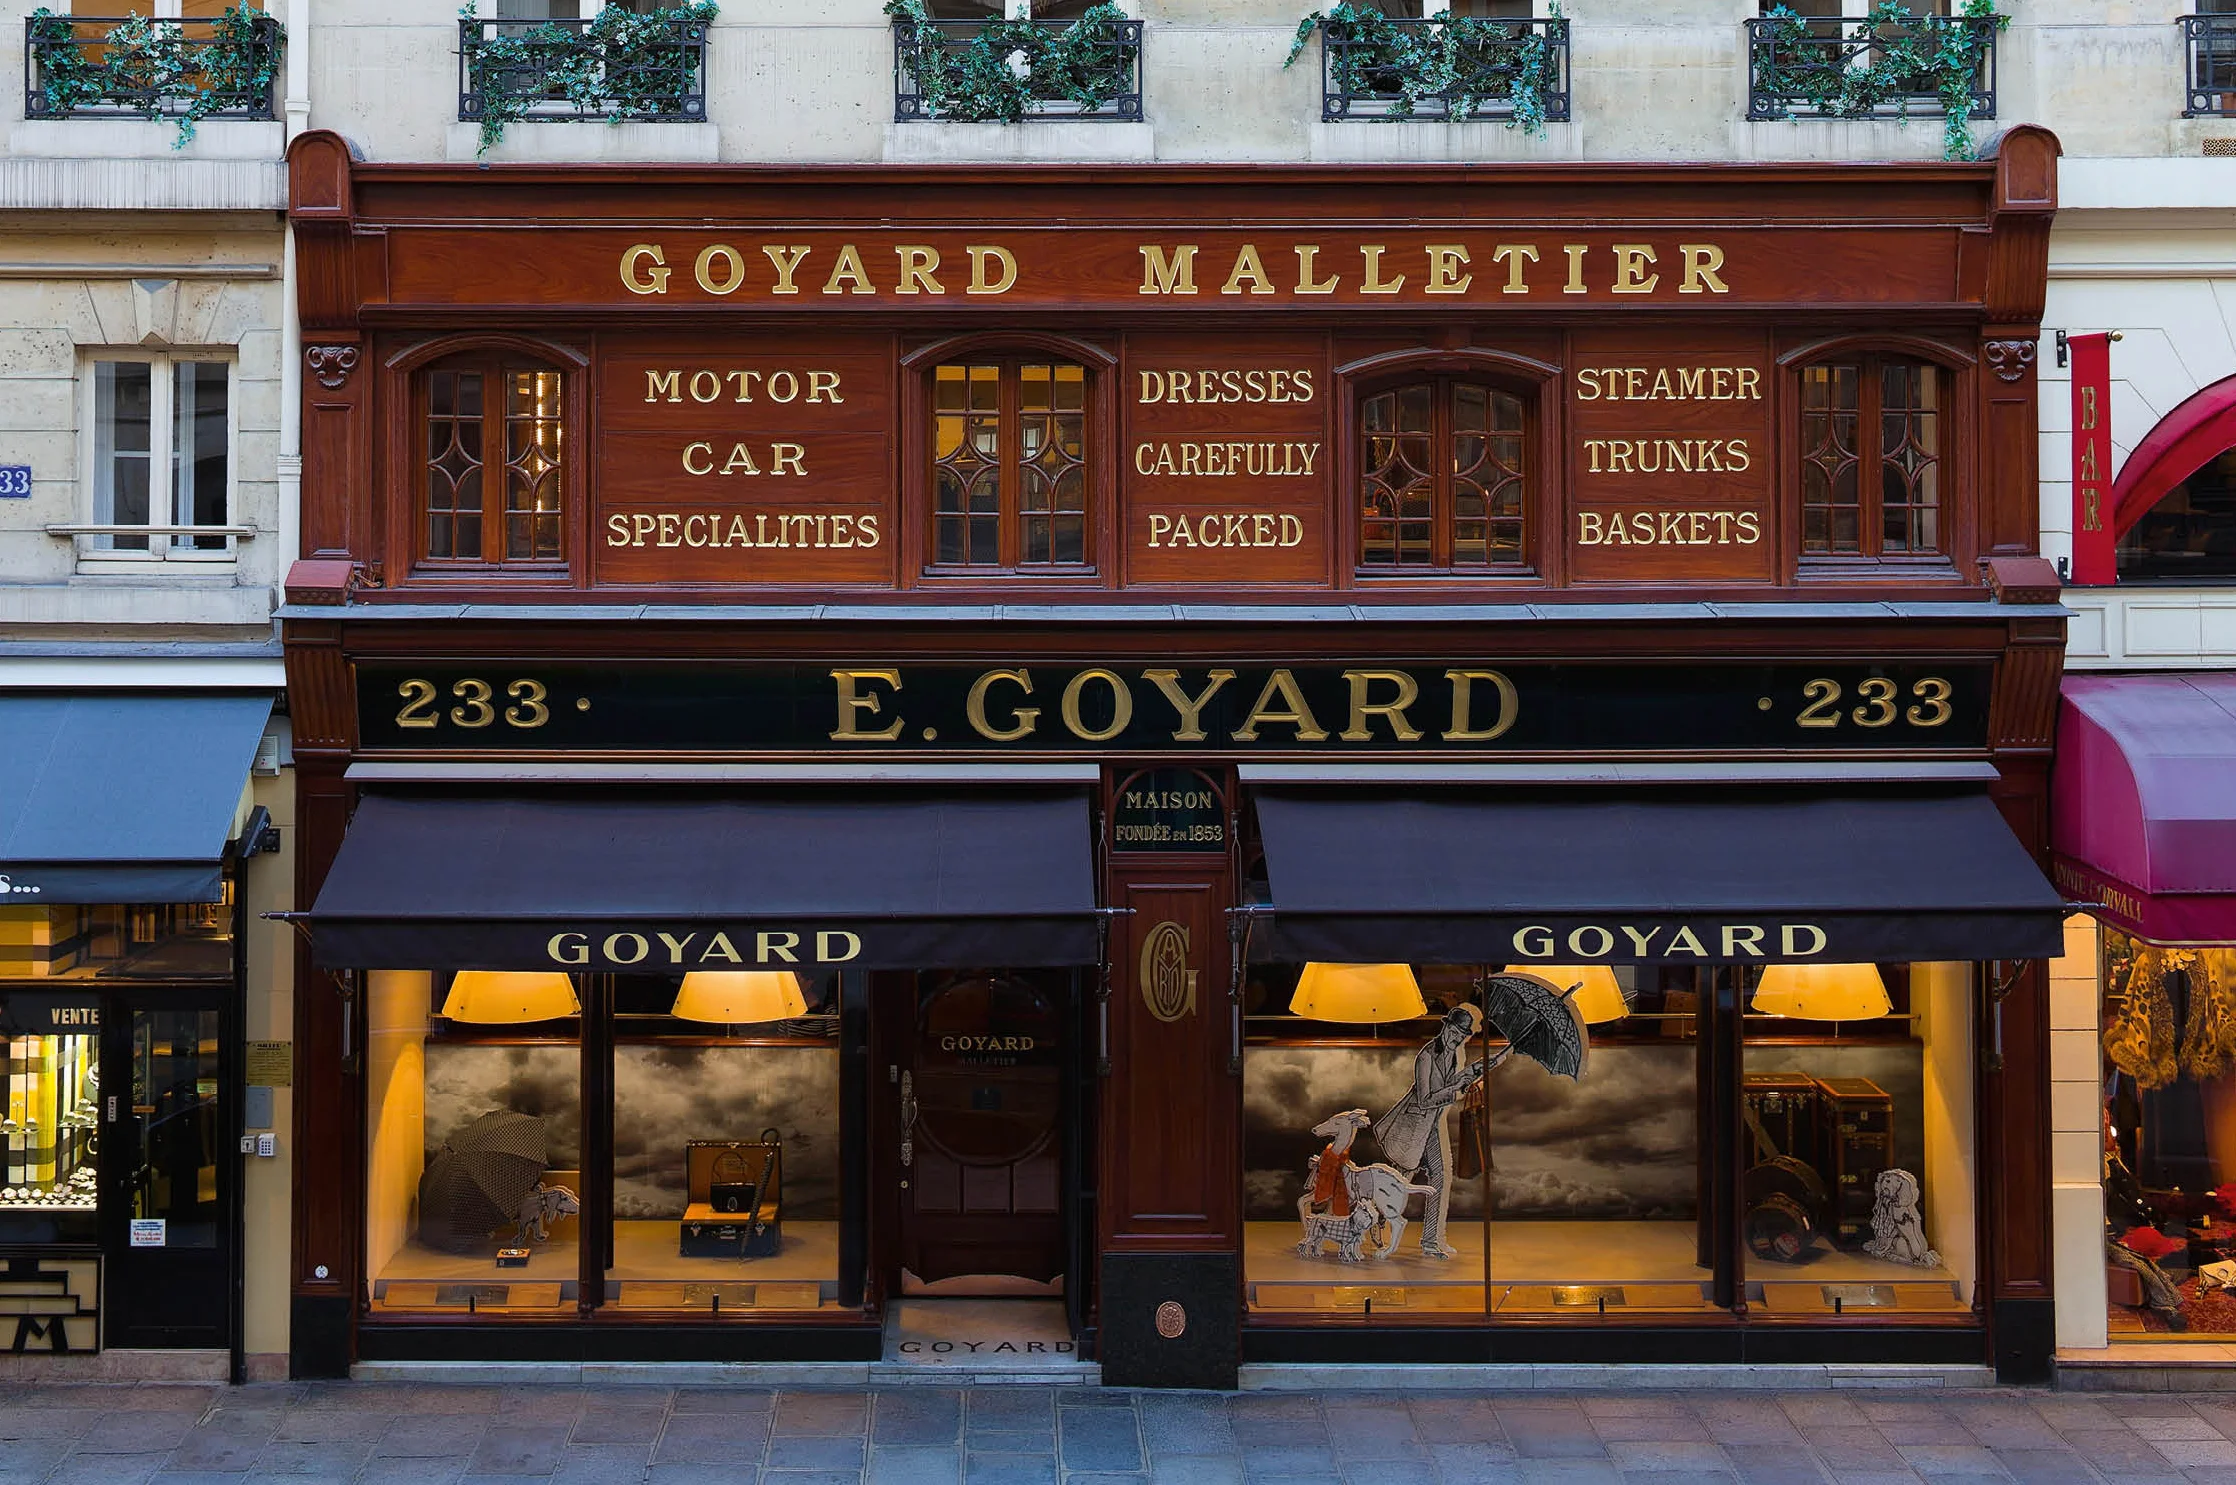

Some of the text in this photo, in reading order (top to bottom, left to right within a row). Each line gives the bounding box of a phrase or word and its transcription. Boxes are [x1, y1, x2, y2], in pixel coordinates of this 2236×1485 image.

[619, 244, 1729, 295] GOYARD MALLETIER
[644, 370, 845, 404] MOTOR
[1138, 369, 1314, 404] DRESSES
[1577, 367, 1762, 401] STEAMER
[682, 441, 809, 476] CAR
[1135, 442, 1320, 476] CAREFULLY
[1583, 438, 1751, 473] TRUNKS
[2081, 386, 2103, 532] BAR
[607, 513, 881, 548] SPECIALITIES
[1147, 513, 1304, 548] PACKED
[1578, 511, 1761, 545] BASKETS
[1125, 790, 1214, 810] MAISON
[1115, 821, 1172, 842] FONDÉE
[1188, 824, 1224, 842] 1853
[547, 931, 862, 964] GOYARD
[1511, 925, 1828, 958] GOYARD
[51, 1007, 100, 1025] VENTE
[940, 1035, 1035, 1052] GOYARD
[899, 1340, 1075, 1354] GOYARD
